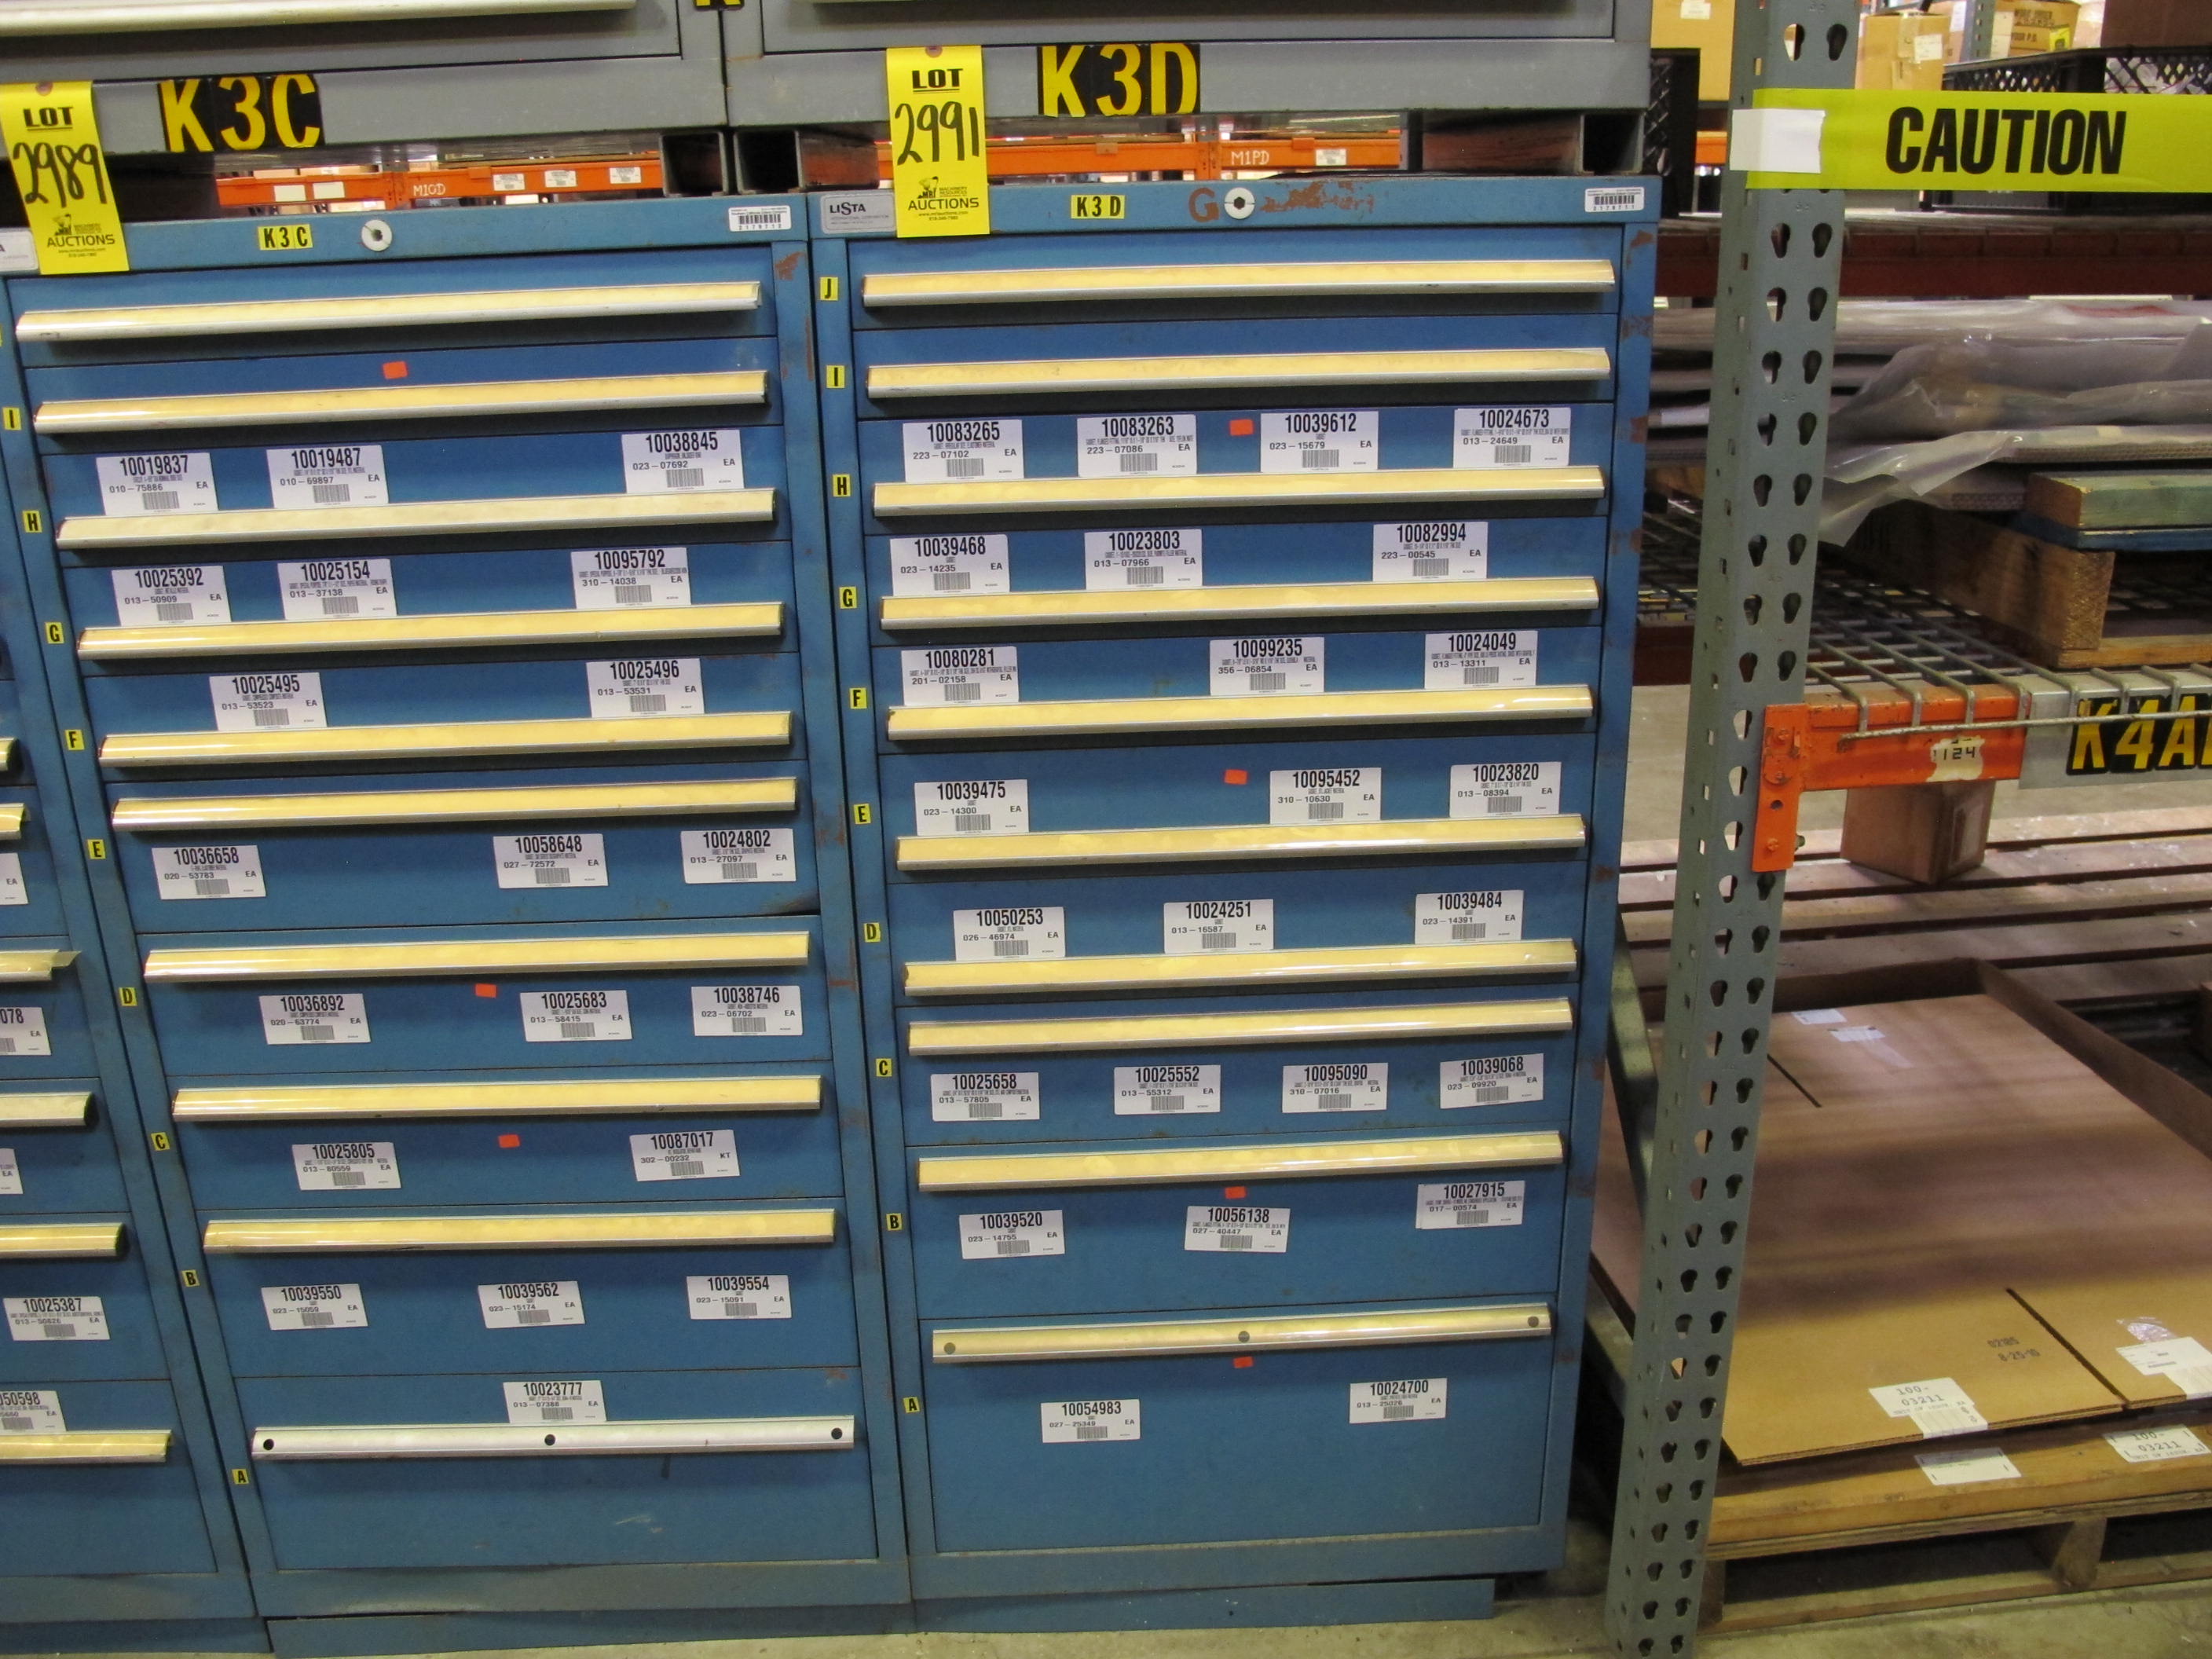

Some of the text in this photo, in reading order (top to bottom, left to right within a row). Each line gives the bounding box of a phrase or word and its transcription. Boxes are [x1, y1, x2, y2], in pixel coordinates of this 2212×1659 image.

[912, 68, 963, 89] LOT
[1042, 42, 1199, 117] K3D
[23, 107, 73, 127] LOT
[162, 74, 320, 152] K3C
[895, 101, 980, 166] 2991
[1884, 107, 2127, 175] CAUTION
[13, 142, 107, 208] 2989
[830, 202, 866, 215] LISTA
[908, 197, 979, 211] AUCTIONS
[1076, 196, 1122, 218] K3D
[47, 234, 115, 247] AUCTIONS
[265, 225, 308, 248] K3C
[825, 278, 832, 299] J
[833, 367, 839, 386] I
[9, 409, 14, 428] I
[1101, 416, 1174, 437] 10083263
[1285, 413, 1357, 433] 10039612
[1479, 409, 1549, 428] 10024673
[927, 421, 1000, 442] 10083265
[646, 432, 718, 453] 10038845
[120, 455, 189, 476] 10019837
[291, 448, 361, 468] 10019487
[837, 476, 848, 496] H
[27, 513, 38, 531] H
[1108, 530, 1180, 551] 10023803
[1397, 523, 1466, 543] 10082994
[914, 536, 986, 557] 10039468
[595, 549, 665, 569] 10095792
[134, 568, 203, 588] 10025392
[301, 561, 370, 581] 10025154
[842, 588, 854, 608] G
[49, 624, 60, 643] G
[1448, 632, 1516, 652] 10024049
[1233, 639, 1302, 657] 10099235
[925, 649, 994, 668] 10080281
[610, 660, 679, 679] 10025496
[233, 675, 300, 694] 10025495
[853, 689, 862, 707] F
[68, 731, 78, 749] F
[2072, 695, 2212, 770] K4A
[1293, 770, 1360, 788] 10095452
[1473, 764, 1539, 782] 10023820
[937, 781, 1005, 800] 10039475
[858, 805, 867, 822] E
[515, 836, 582, 853] 10058648
[703, 830, 771, 848] 10024802
[92, 841, 103, 858] E
[174, 848, 239, 865] 10036658
[1186, 901, 1251, 919] 10024251
[1437, 892, 1502, 910] 10039484
[976, 909, 1043, 926] 10050253
[866, 924, 877, 939] D
[122, 988, 134, 1005] D
[280, 995, 344, 1012] 10036892
[541, 992, 606, 1009] 10025683
[714, 987, 779, 1003] 10038746
[878, 1060, 888, 1075] C
[1135, 1067, 1199, 1082] 10025552
[1304, 1064, 1368, 1082] 10095090
[1461, 1057, 1523, 1076] 10039068
[952, 1074, 1016, 1090] 10025658
[155, 1133, 166, 1150] C
[650, 1132, 713, 1150] 10087017
[313, 1143, 375, 1159] 10025805
[1444, 1182, 1505, 1199] 10027915
[889, 1214, 899, 1229] B
[980, 1212, 1042, 1229] 10039520
[1207, 1208, 1269, 1223] 10056138
[185, 1271, 196, 1286] B
[708, 1276, 769, 1291] 10039554
[281, 1286, 341, 1302] 10039550
[498, 1284, 559, 1299] 10039562
[23, 1298, 82, 1312] 10025387
[523, 1382, 582, 1396] 10023777
[1370, 1380, 1428, 1396] 10024700
[907, 1397, 918, 1412] A
[1062, 1401, 1122, 1416] 10054983
[1901, 1394, 1946, 1406] 03211
[236, 1470, 247, 1484] A
